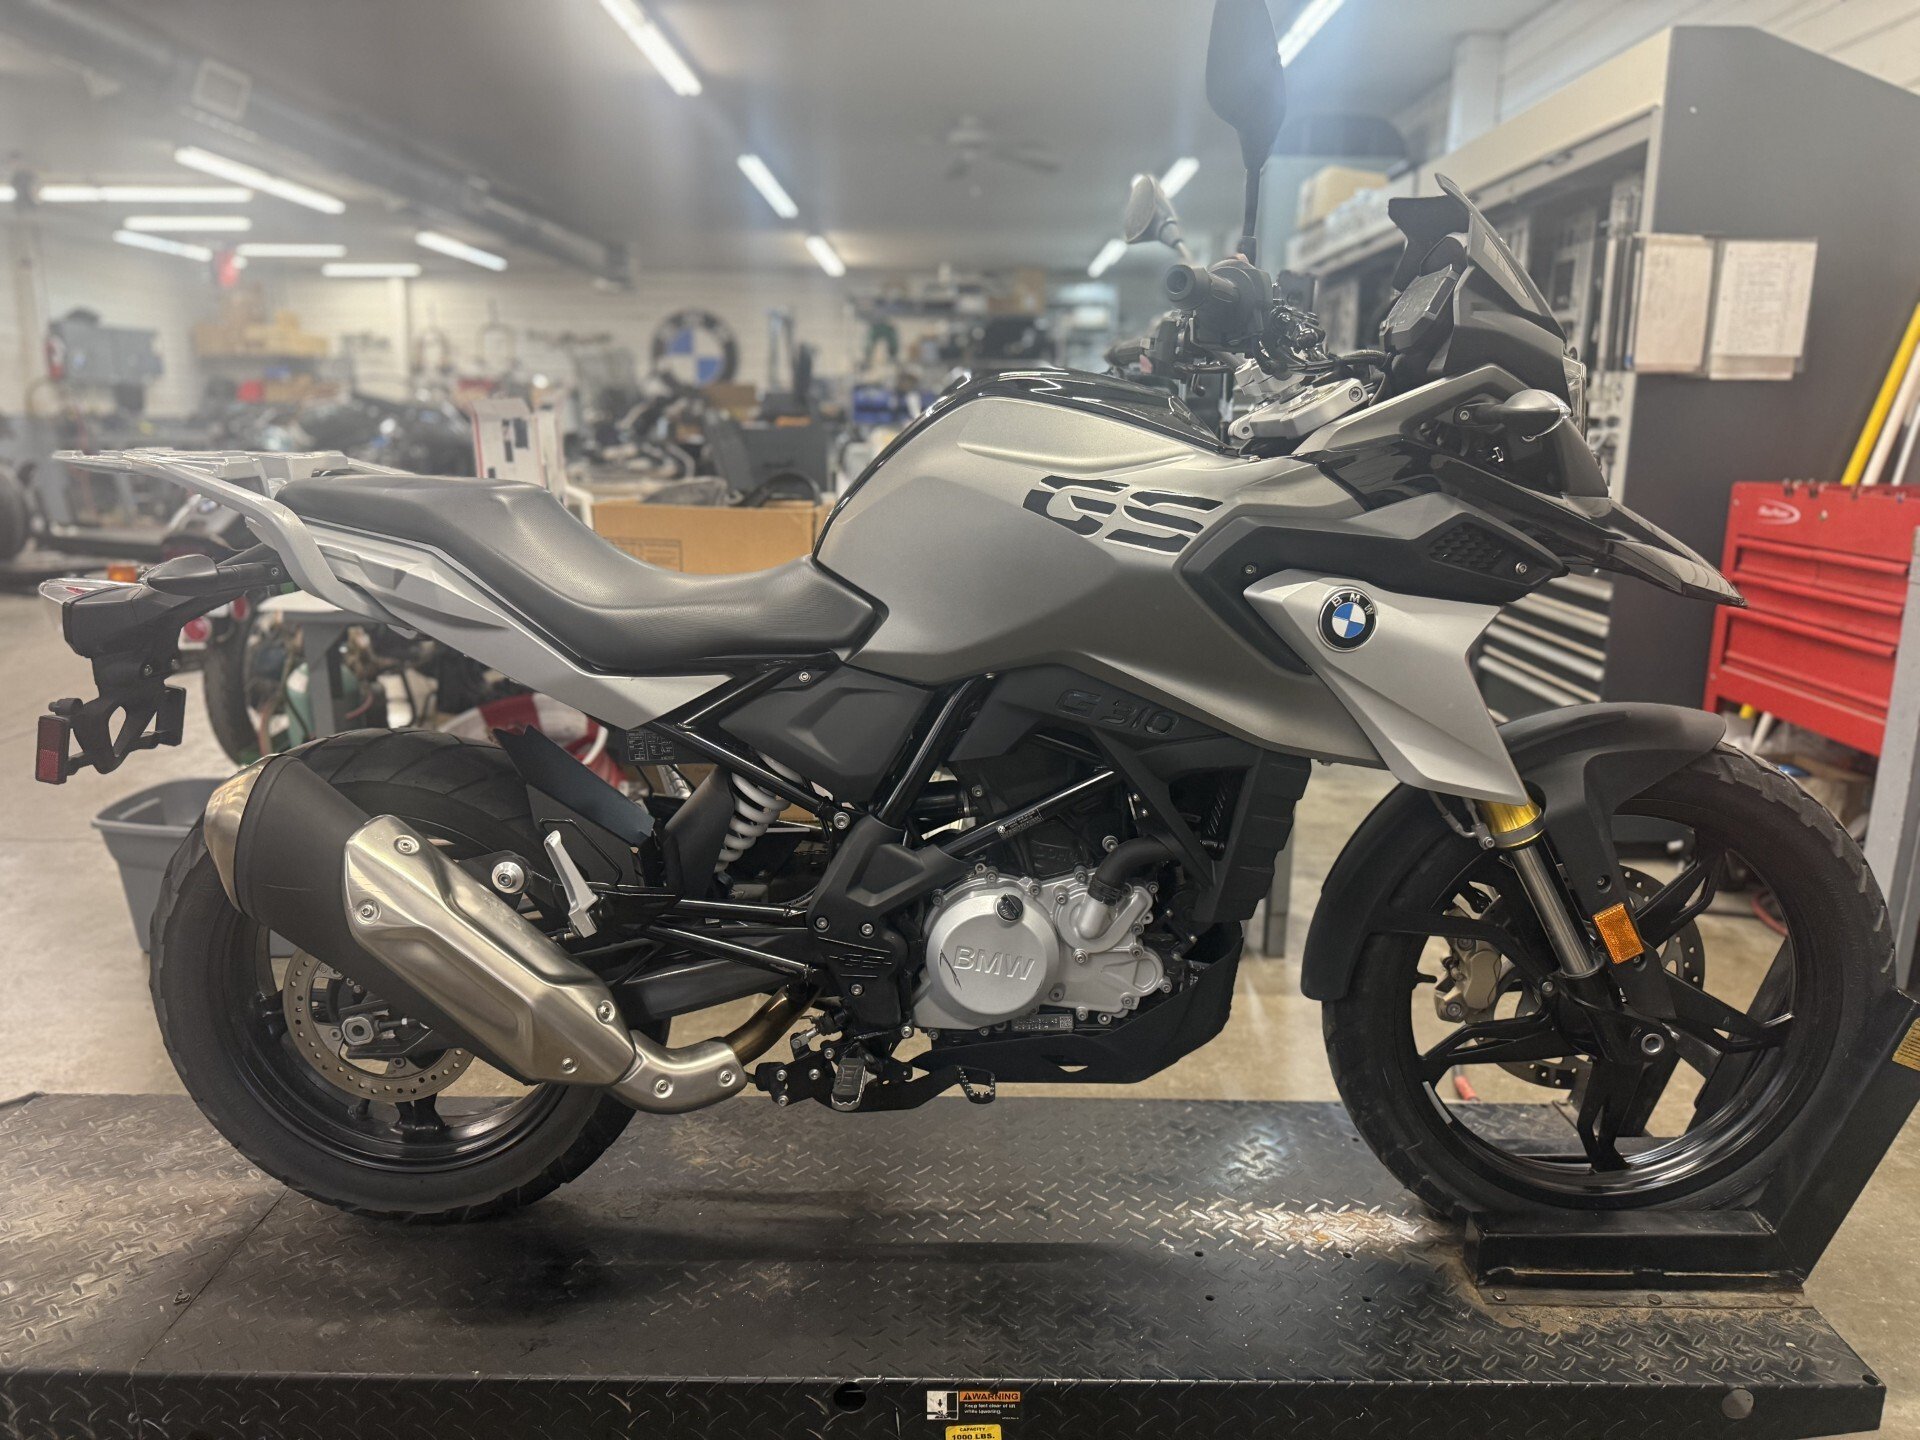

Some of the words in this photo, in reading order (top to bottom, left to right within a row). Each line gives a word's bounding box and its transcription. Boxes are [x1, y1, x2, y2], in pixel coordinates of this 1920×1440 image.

[1022, 475, 1223, 555] GS
[1331, 592, 1374, 616] BMW
[1056, 689, 1101, 719] G
[1100, 699, 1180, 735] 310
[953, 945, 1035, 980] BMW
